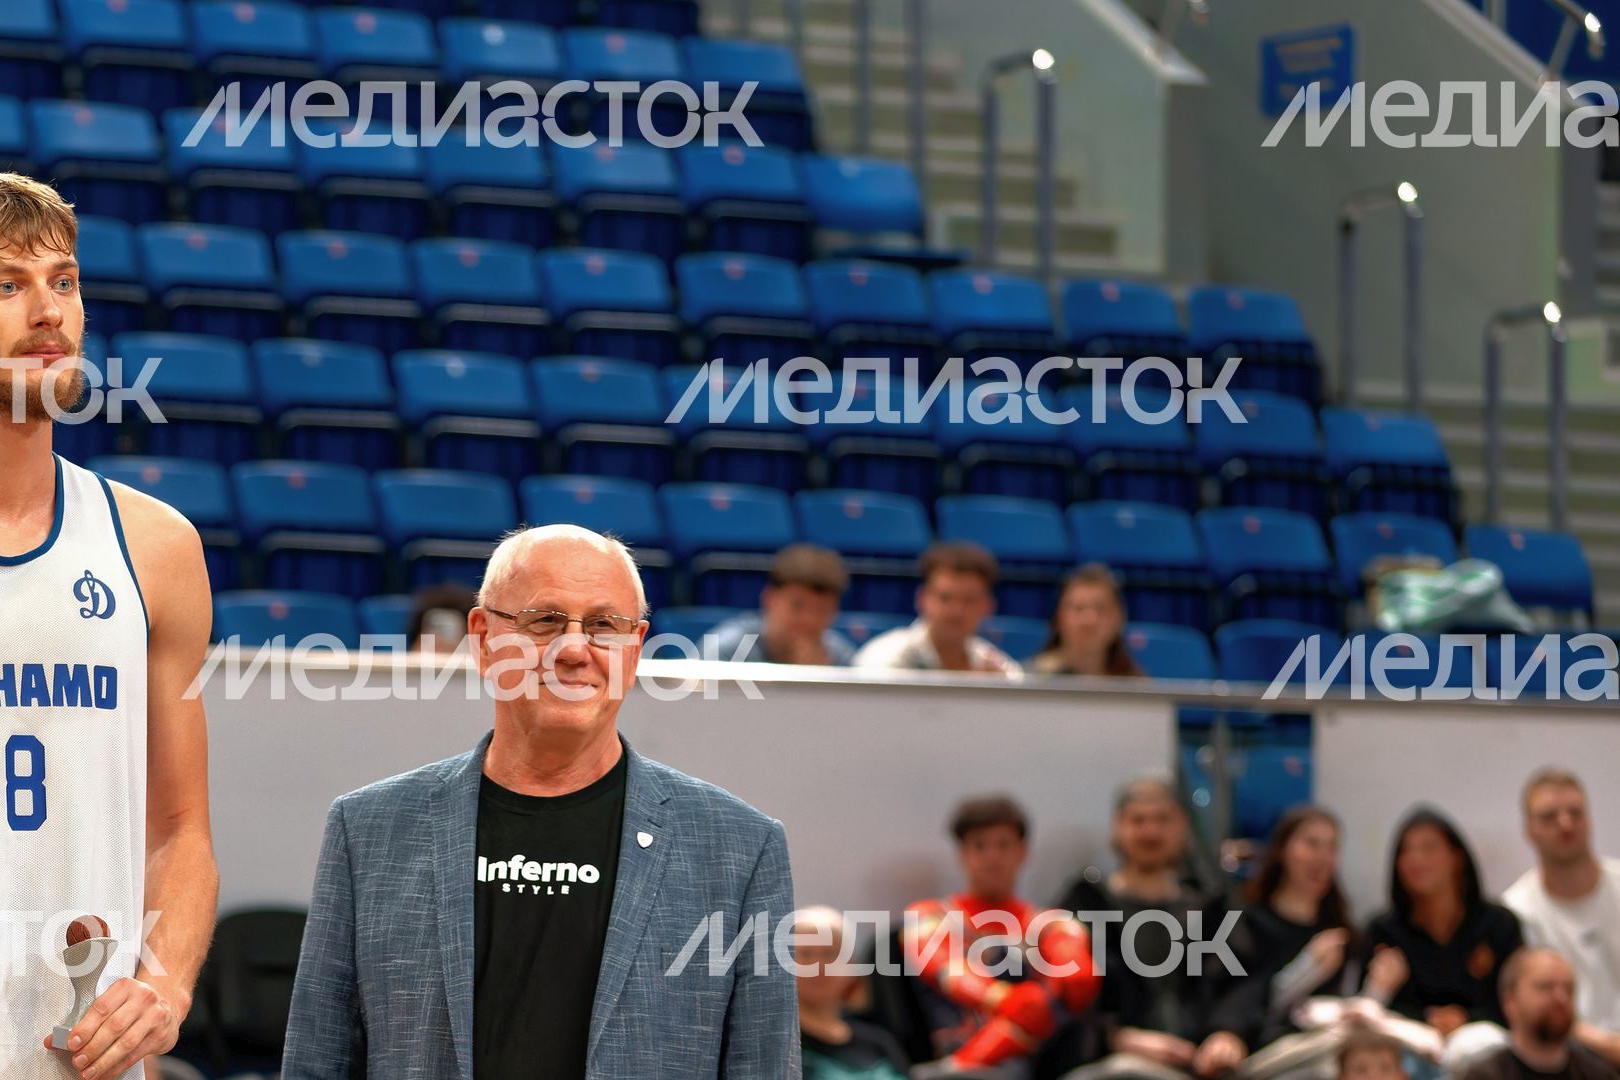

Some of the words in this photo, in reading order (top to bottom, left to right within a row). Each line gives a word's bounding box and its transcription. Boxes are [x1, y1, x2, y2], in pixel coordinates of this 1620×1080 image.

[5, 735, 47, 831] 8
[477, 854, 600, 884] Inferno
[502, 883, 570, 895] STYLE
